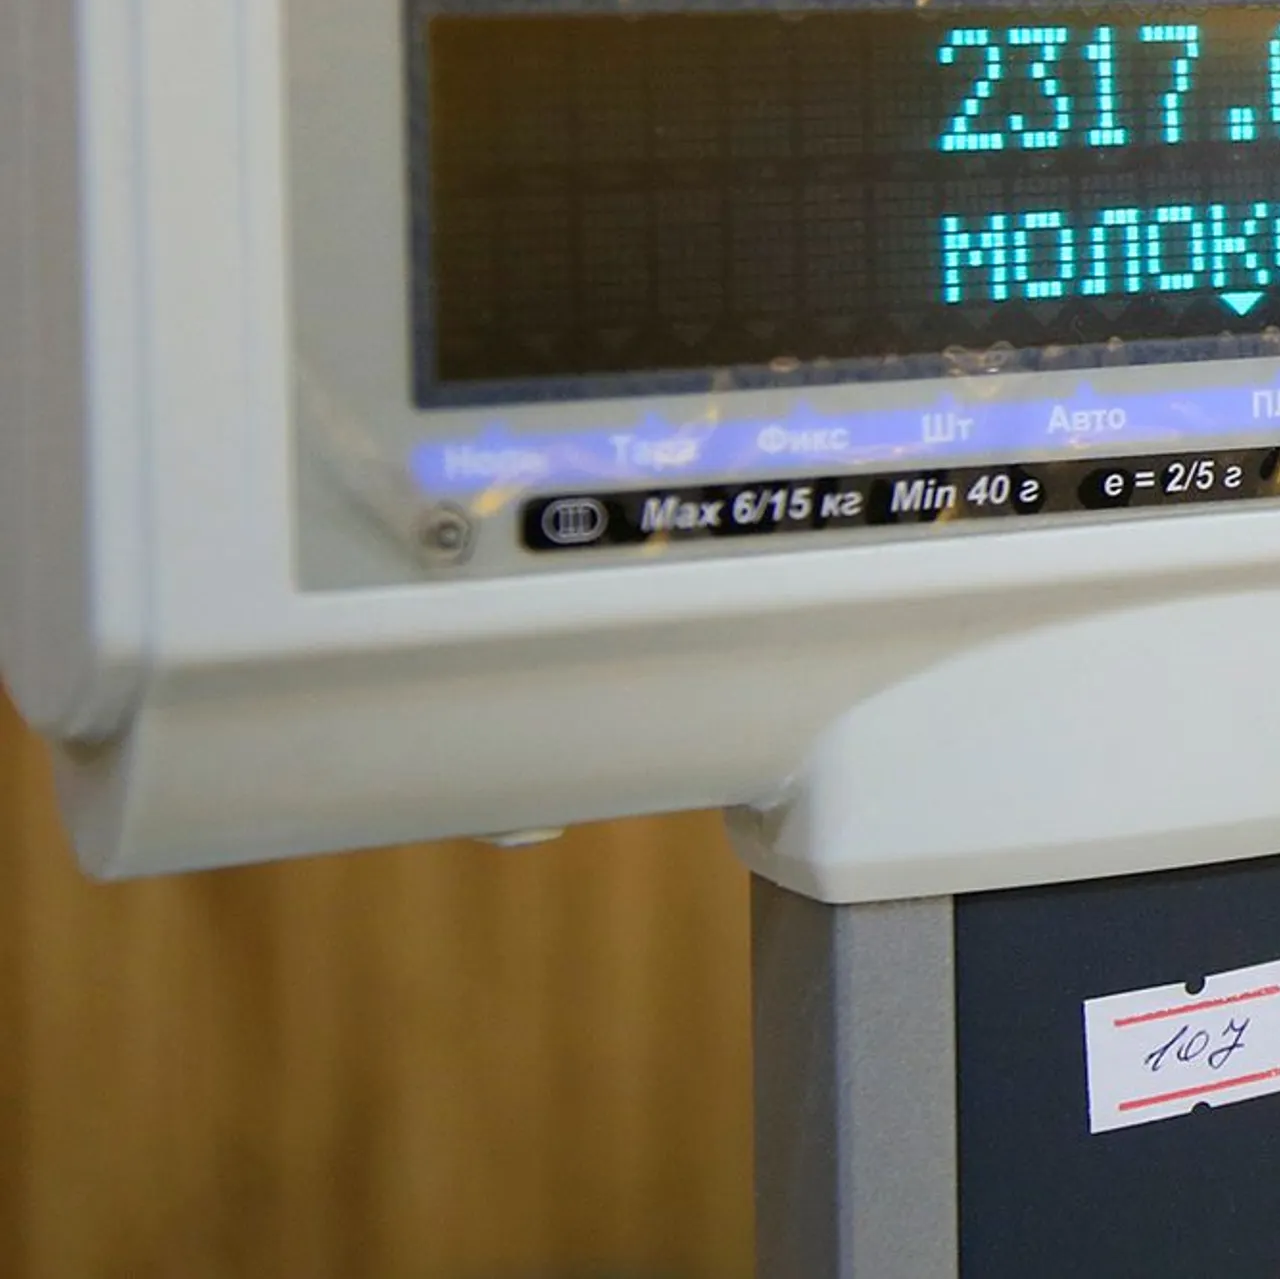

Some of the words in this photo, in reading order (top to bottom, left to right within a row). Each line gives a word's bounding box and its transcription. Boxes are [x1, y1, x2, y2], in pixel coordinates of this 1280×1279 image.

[920, 413, 974, 444] Шт
[1046, 404, 1127, 435] Авто
[755, 423, 850, 456] Фикс
[640, 495, 722, 533] Max
[732, 486, 813, 525] 6/15
[889, 479, 958, 514] Min
[966, 474, 1011, 507] 40
[1165, 460, 1215, 494] 2/5
[1144, 1017, 1251, 1072] 107
